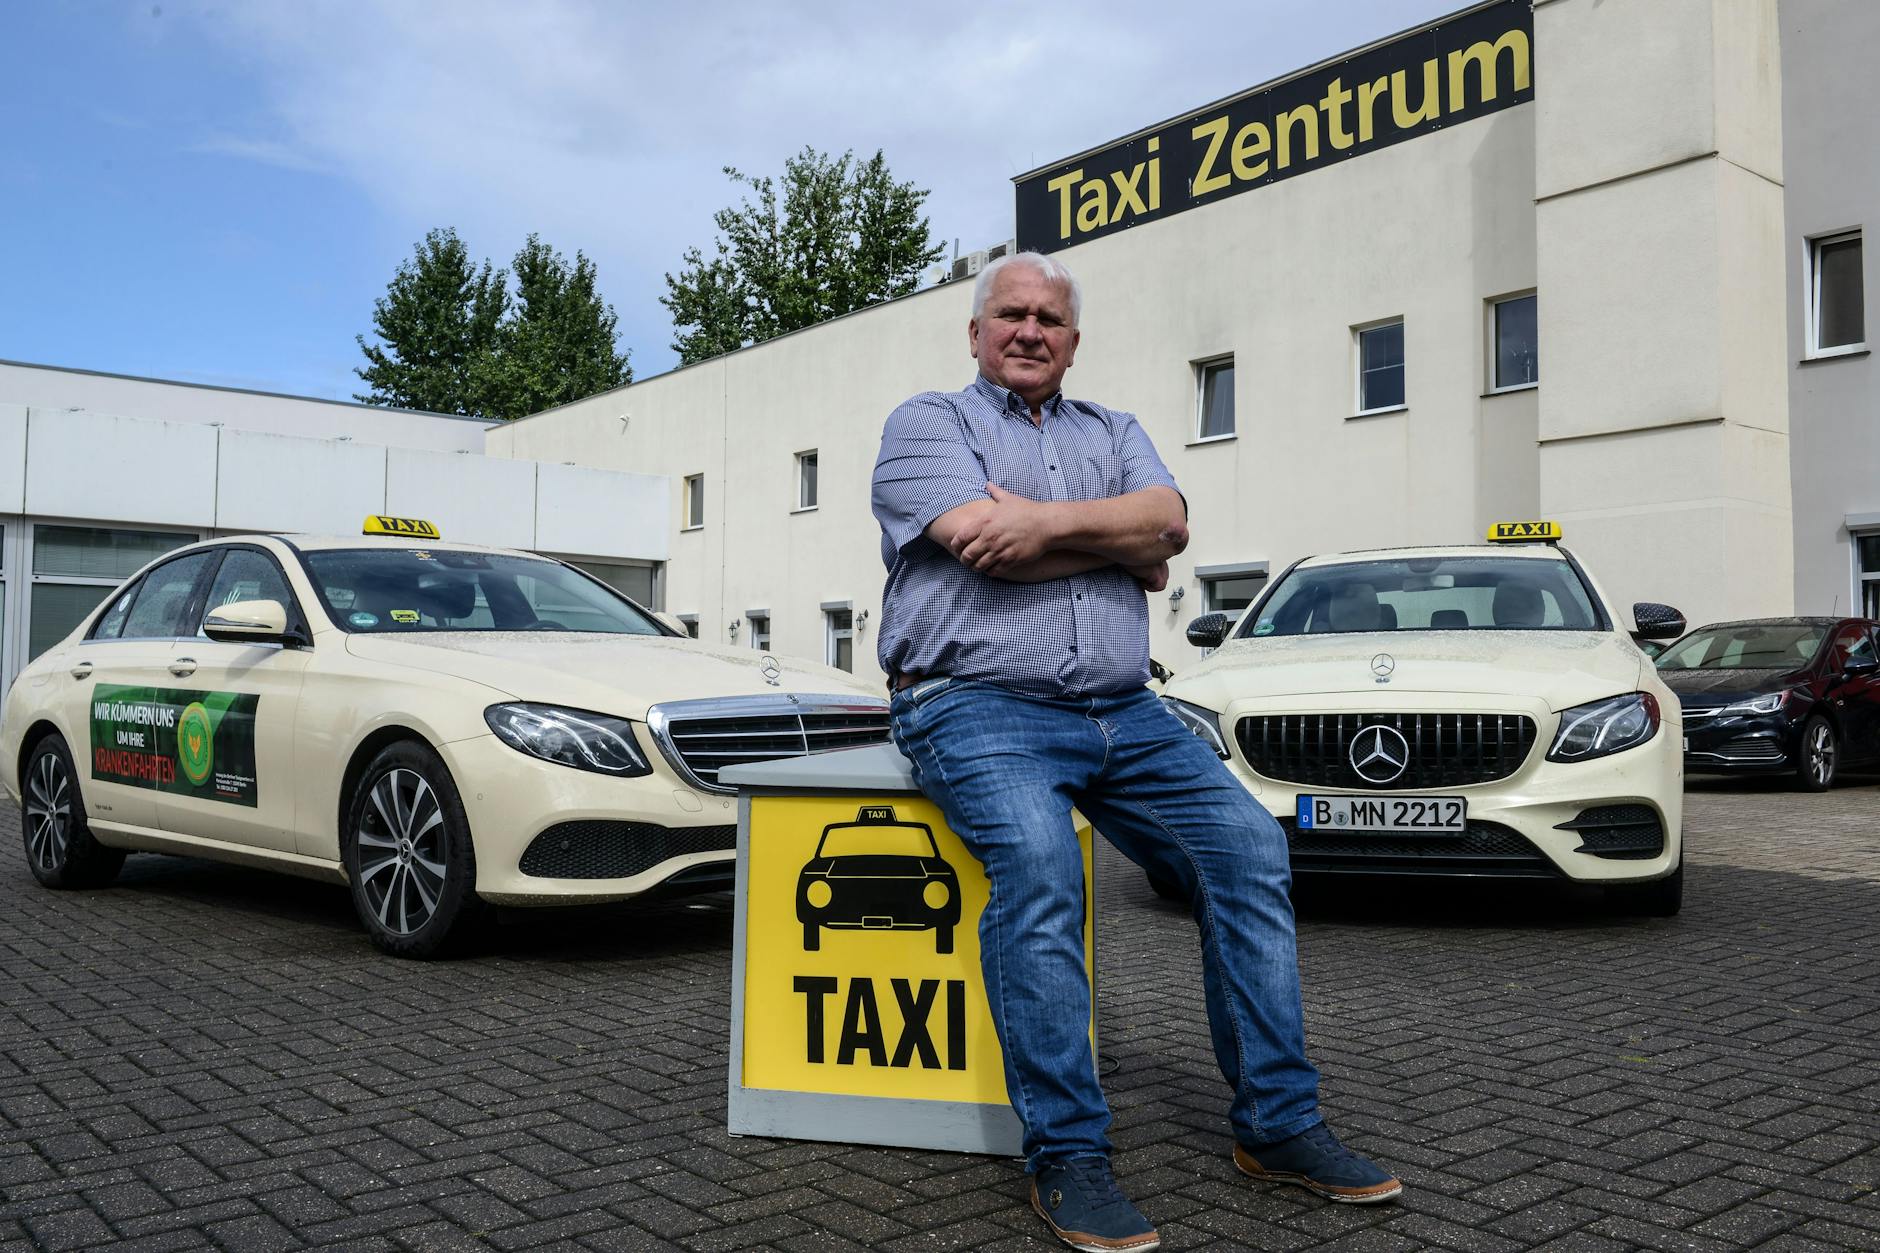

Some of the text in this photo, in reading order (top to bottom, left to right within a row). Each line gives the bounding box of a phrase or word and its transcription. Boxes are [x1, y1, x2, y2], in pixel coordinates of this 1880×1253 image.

[1048, 29, 1531, 239] Taxi Zentrum
[380, 517, 432, 534] TAXI
[1500, 523, 1549, 536] TAXI
[95, 701, 174, 728] WIR KÜMMERN UNS
[117, 730, 144, 747] UM IHRE
[95, 747, 175, 784] KRANKENFAHRTEN
[867, 810, 887, 819] TAXI
[1315, 800, 1462, 827] B MN 2212
[793, 976, 967, 1071] TAXI
